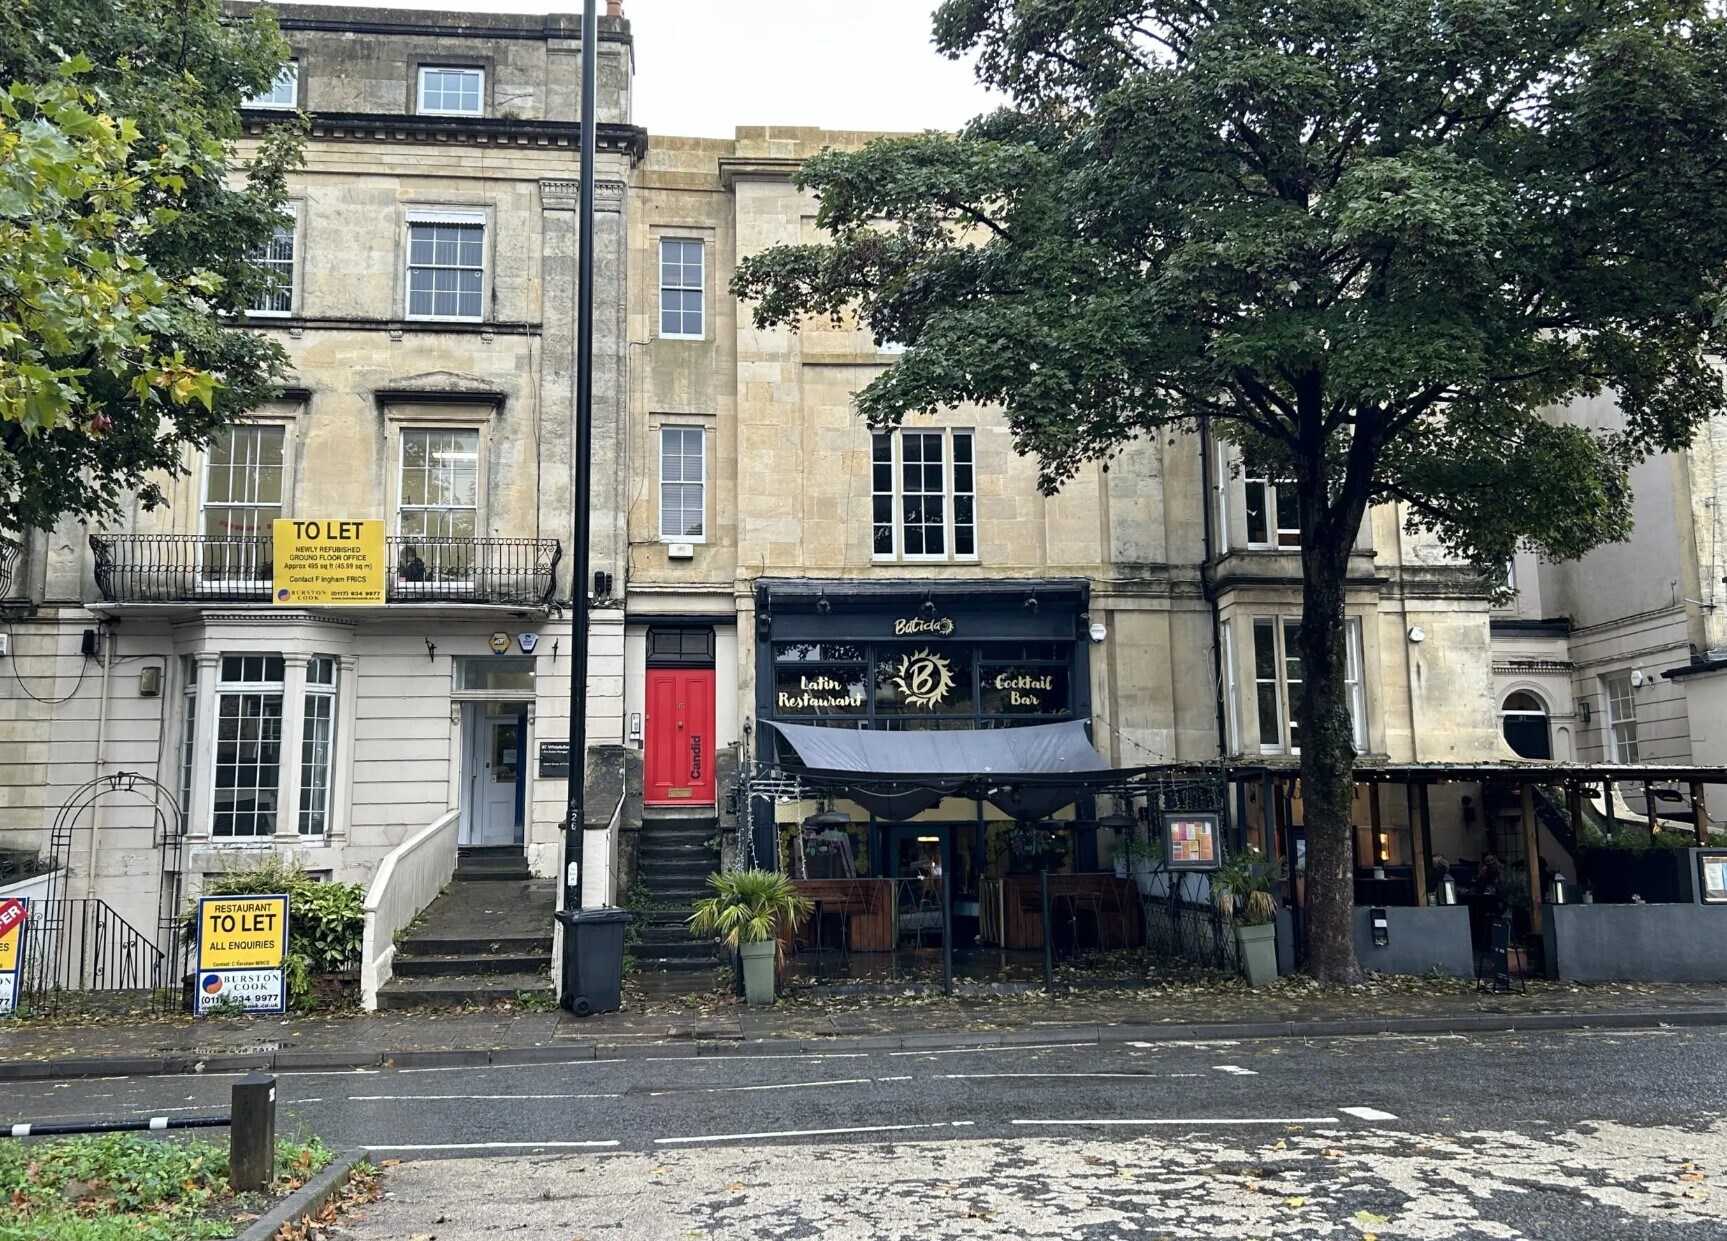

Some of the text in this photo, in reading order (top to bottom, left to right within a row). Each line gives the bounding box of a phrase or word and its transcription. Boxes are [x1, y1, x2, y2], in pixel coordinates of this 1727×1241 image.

[293, 522, 320, 540] TO
[327, 522, 364, 540] LET
[321, 576, 345, 584] Ingham
[894, 618, 941, 634] Batida
[801, 675, 842, 691] Latin
[995, 675, 1052, 691] Cocktail
[778, 691, 863, 707] Restaurant
[1011, 691, 1039, 705] Bar
[690, 735, 701, 779] Candid
[215, 903, 272, 913] RESTAURANT
[210, 913, 277, 932] TO LET
[210, 940, 275, 950] ALL ENQUIRIES
[224, 974, 279, 983] BURSTON
[234, 983, 267, 991] COOK
[255, 994, 279, 1002] 9977
